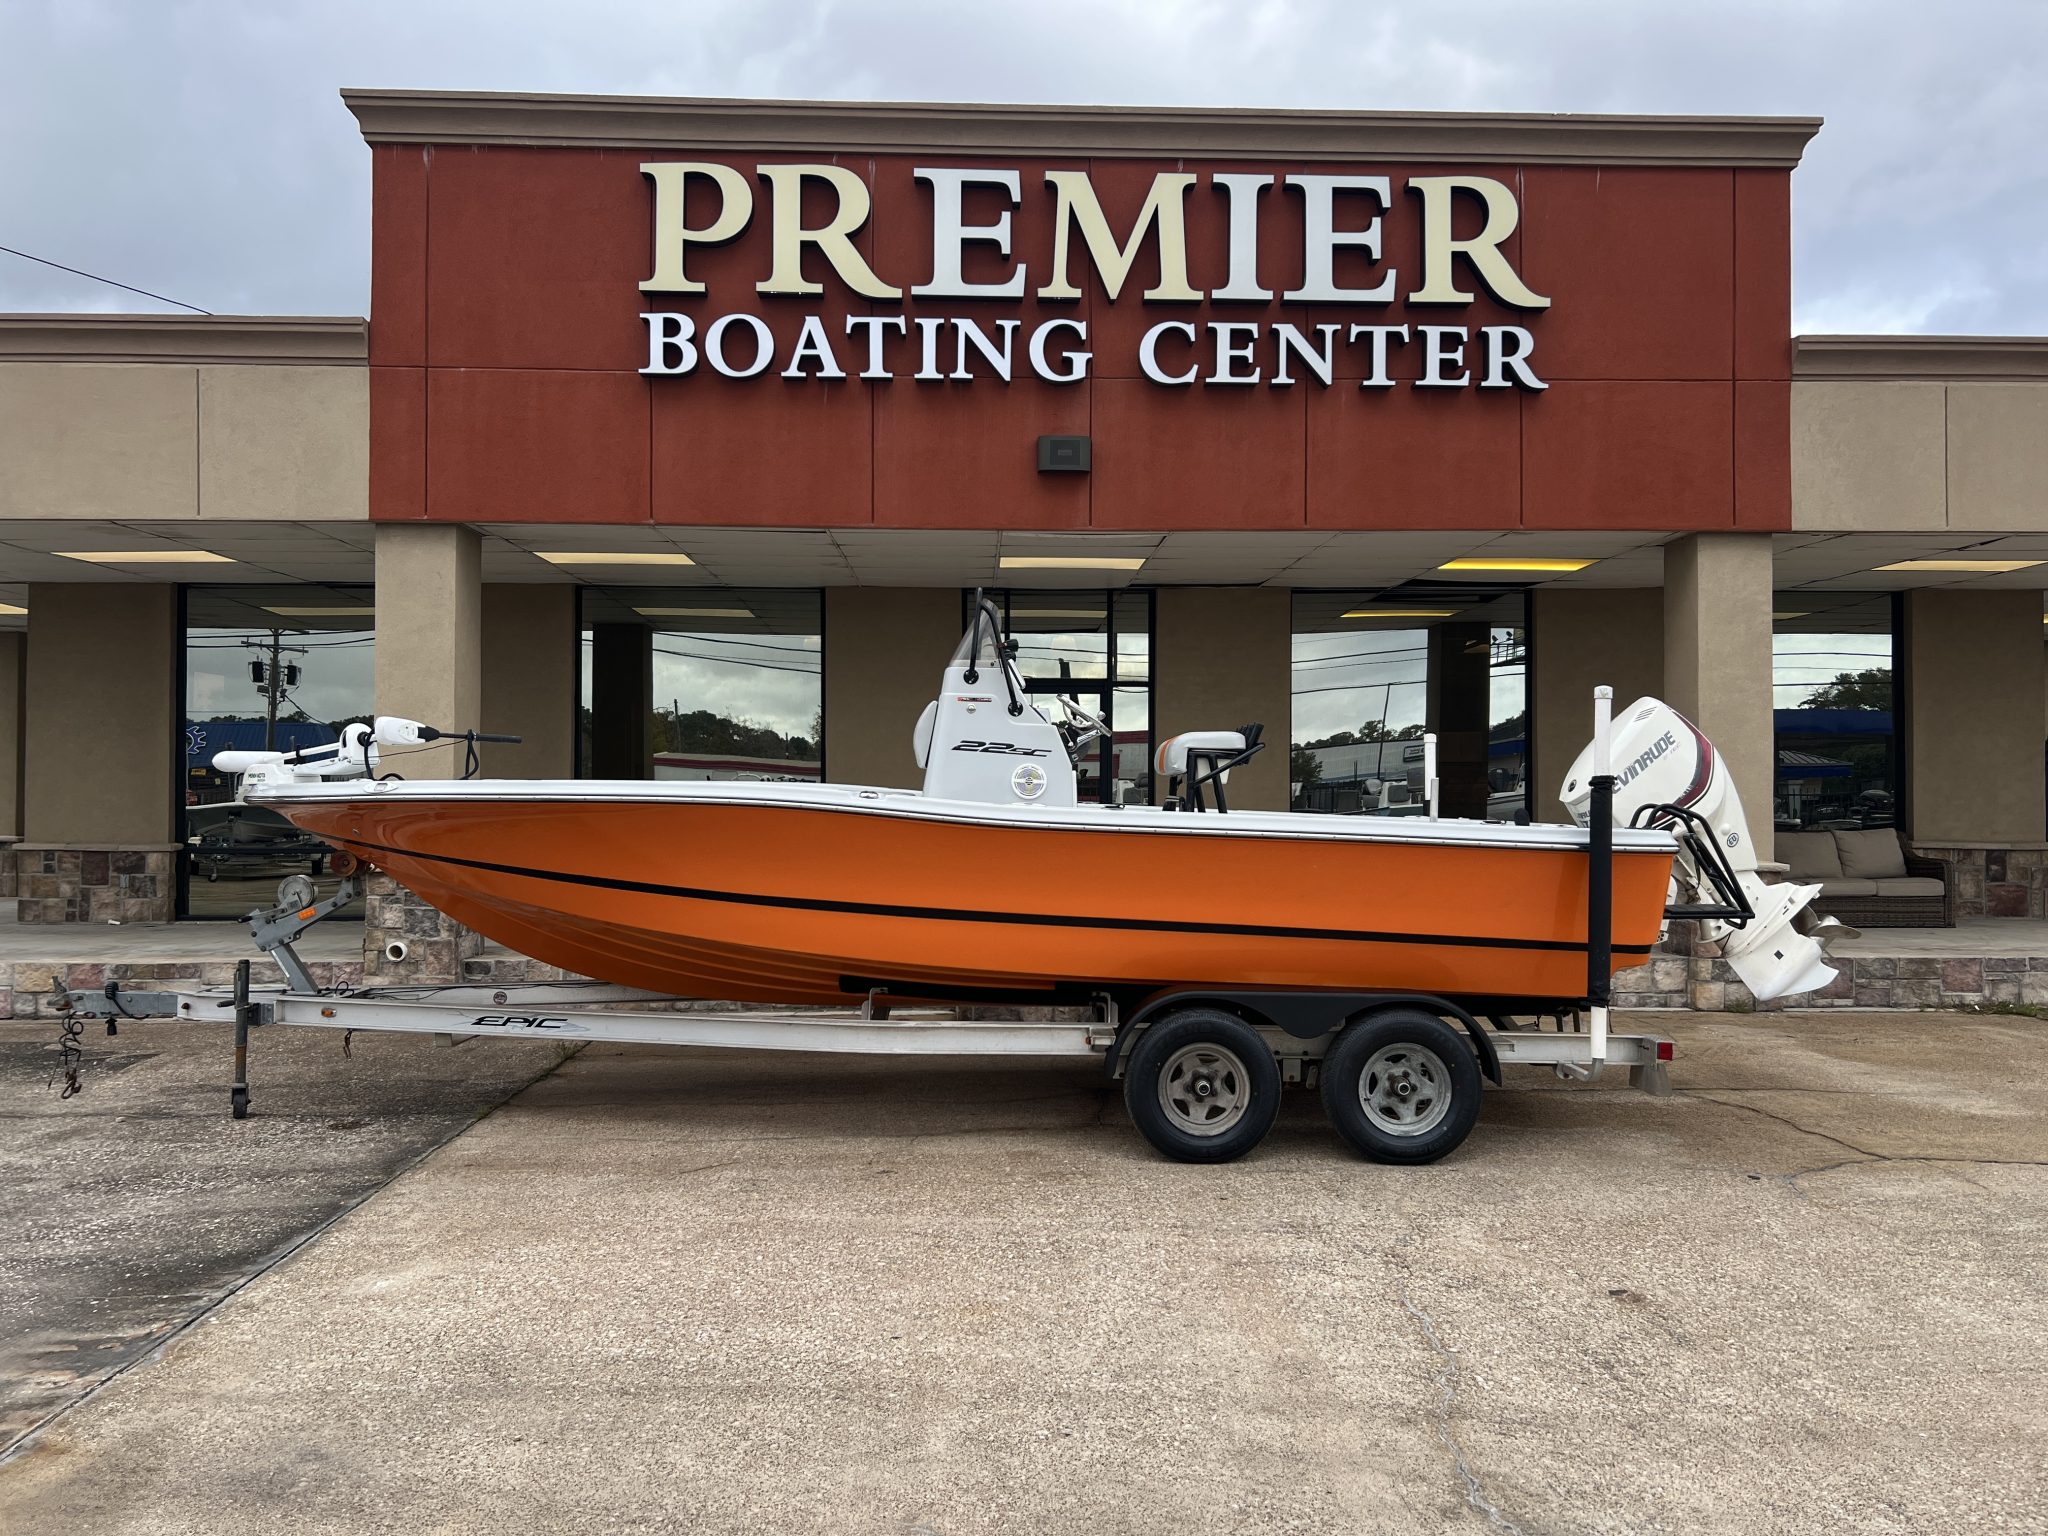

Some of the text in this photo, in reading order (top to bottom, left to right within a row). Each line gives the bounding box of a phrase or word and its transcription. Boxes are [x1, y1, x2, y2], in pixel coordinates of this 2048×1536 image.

[638, 162, 1551, 309] PREMIER
[638, 312, 1549, 389] BOATING CENTER
[1612, 730, 1676, 794] EVINRUDE
[471, 1015, 569, 1029] EPIC
